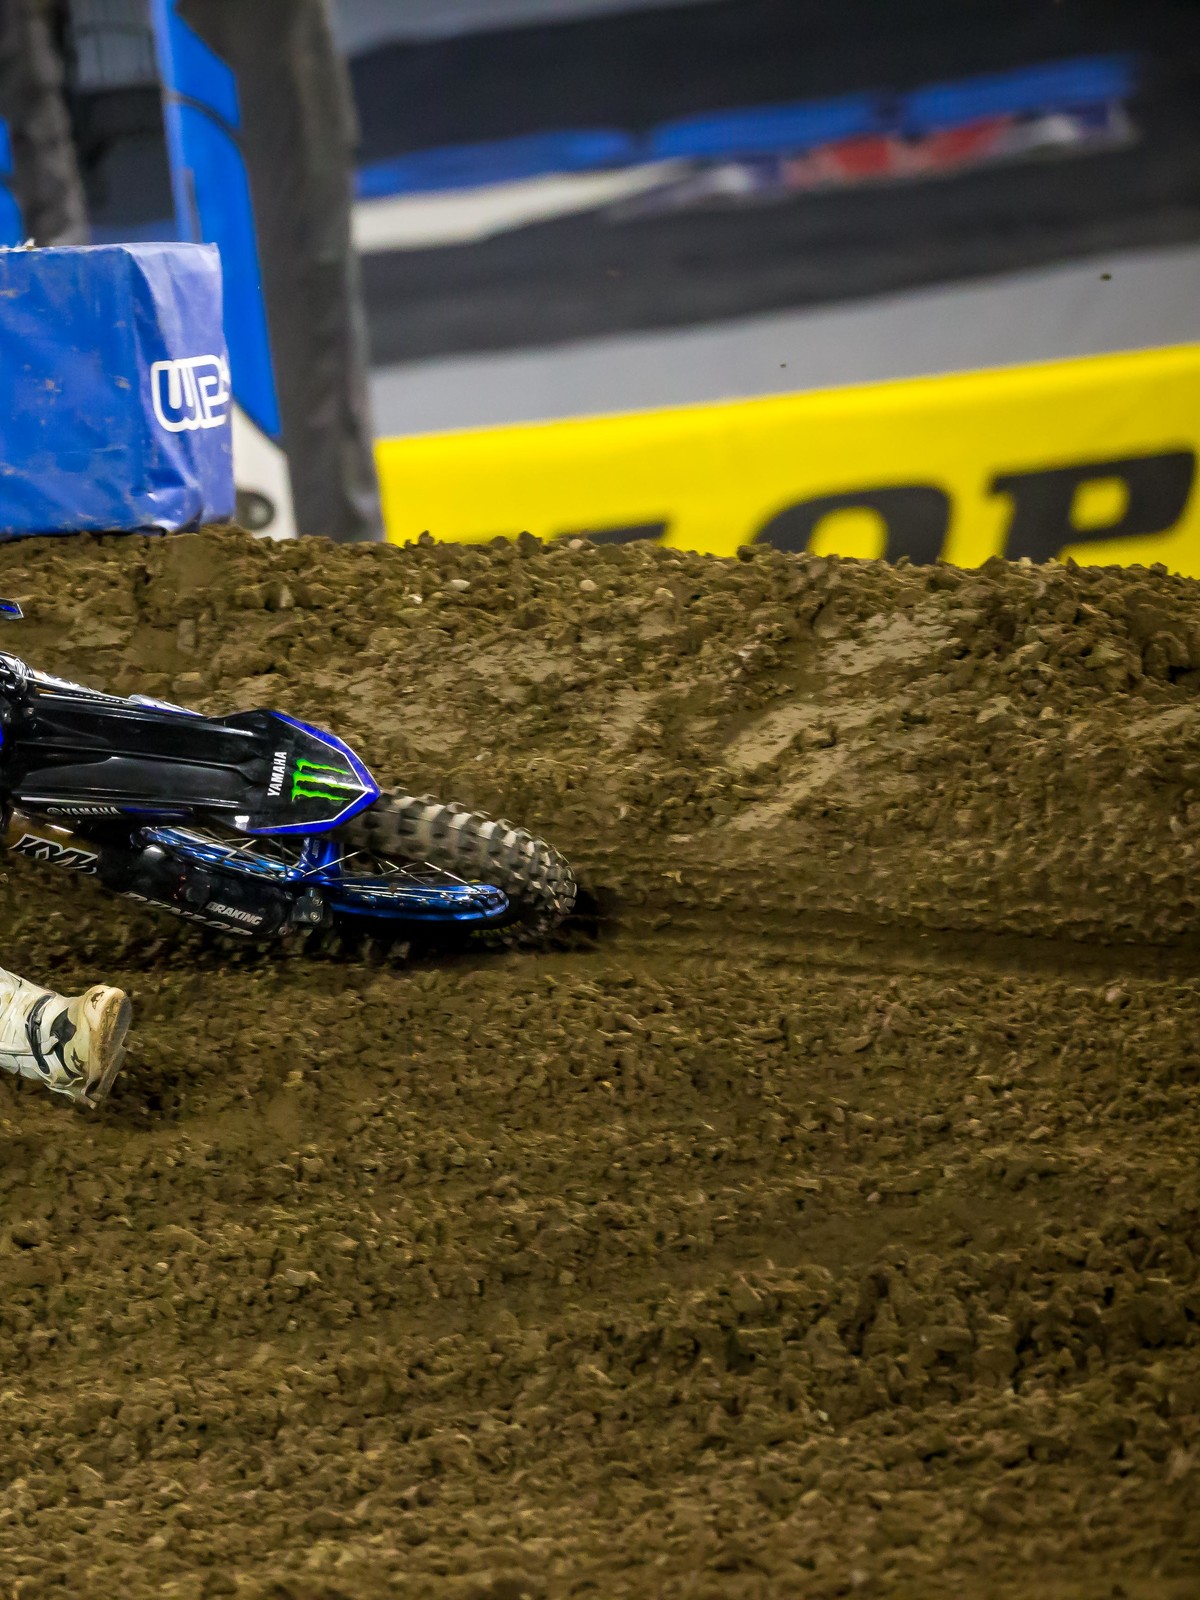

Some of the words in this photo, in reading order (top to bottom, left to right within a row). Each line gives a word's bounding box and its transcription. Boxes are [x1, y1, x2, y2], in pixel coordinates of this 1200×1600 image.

[267, 751, 287, 796] YAMAHA
[61, 806, 121, 816] YAMAHA
[205, 901, 264, 926] BRAKING
